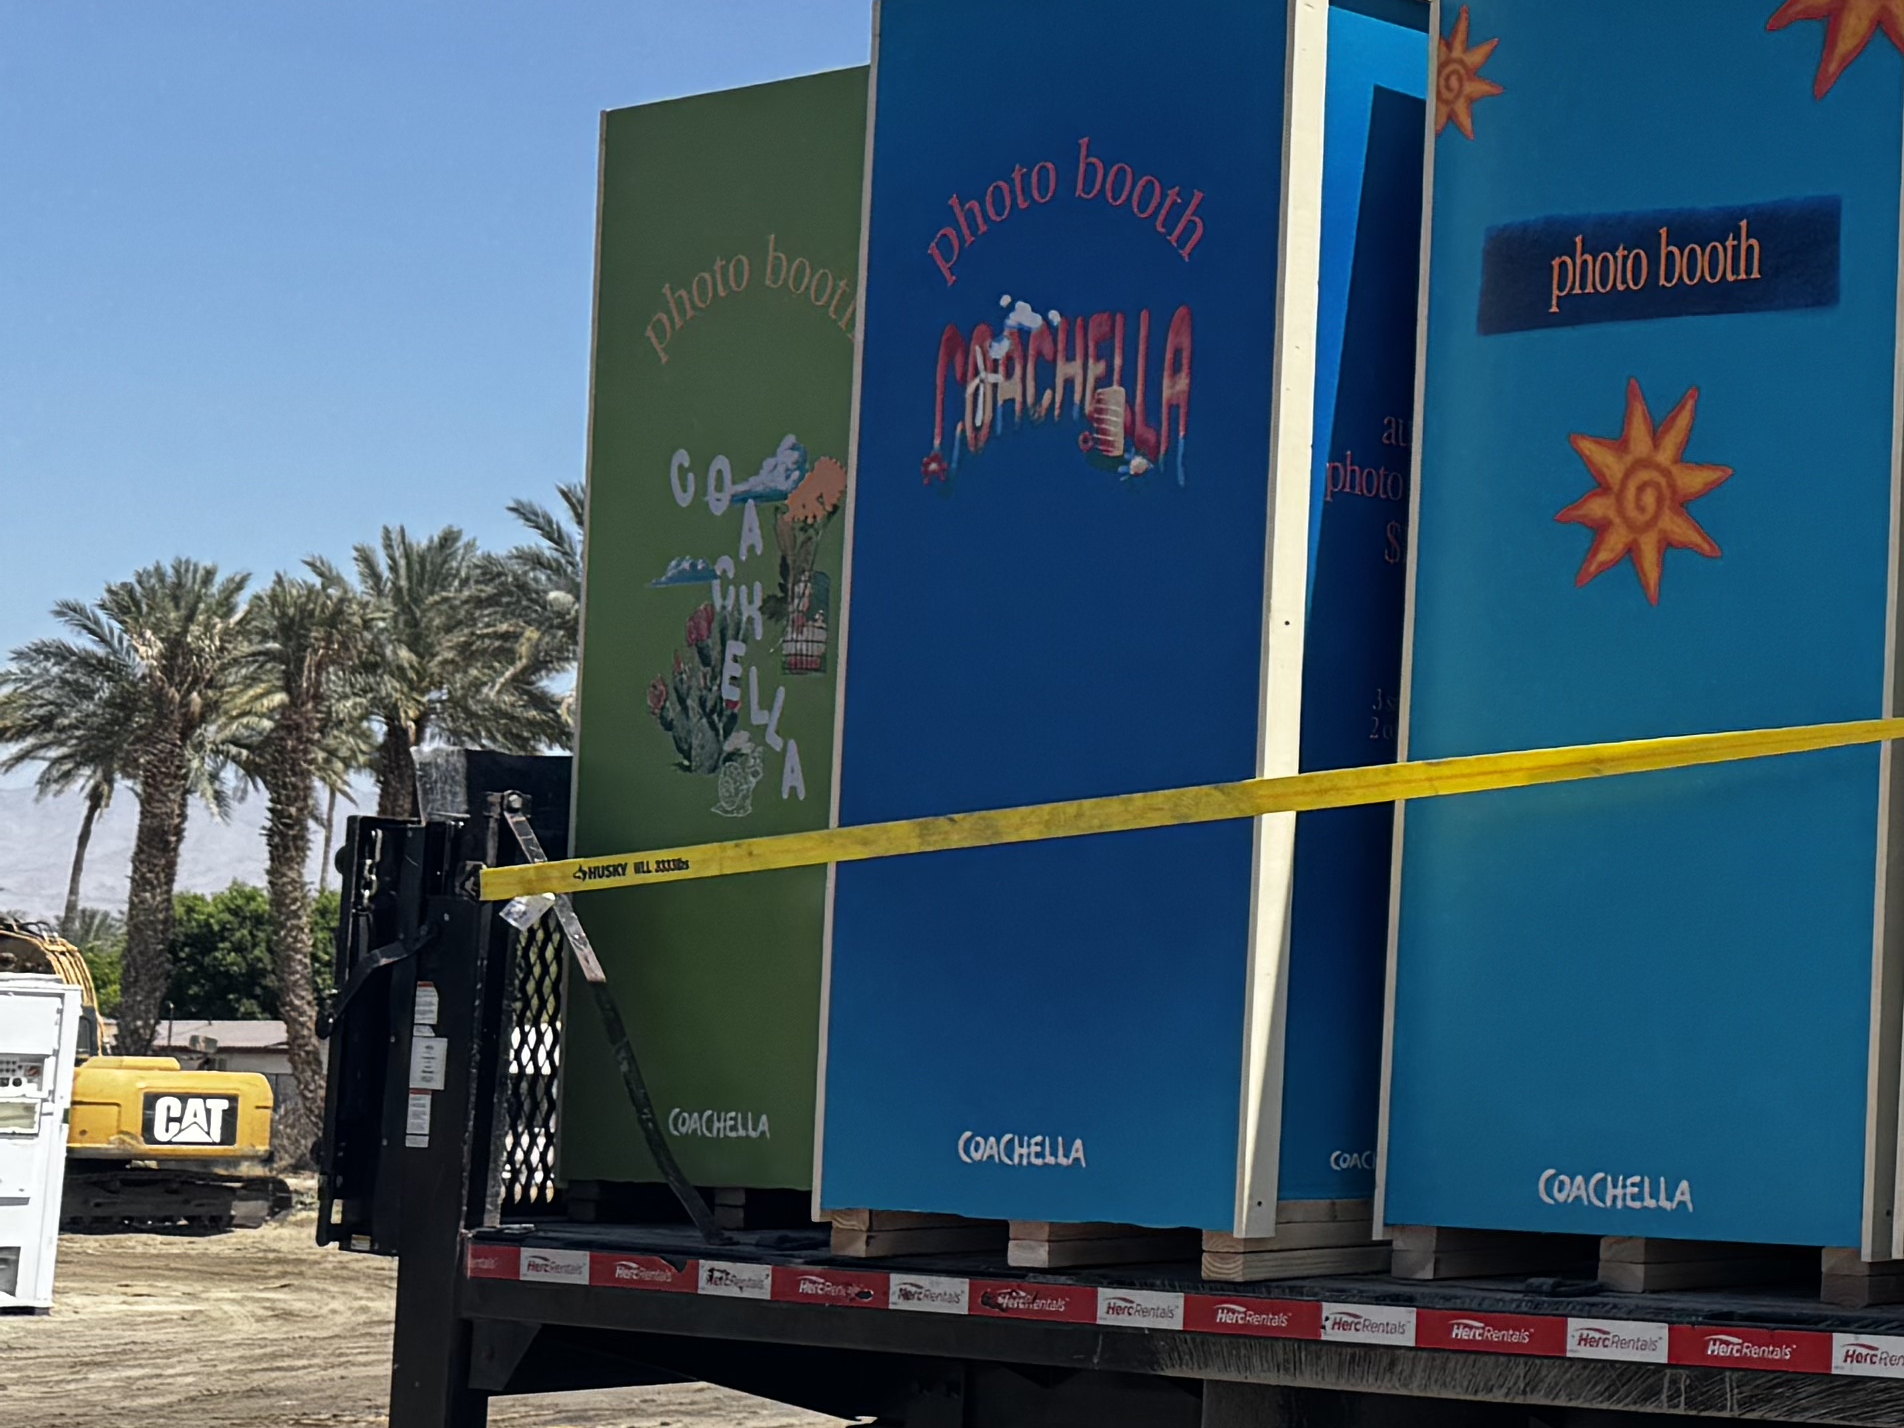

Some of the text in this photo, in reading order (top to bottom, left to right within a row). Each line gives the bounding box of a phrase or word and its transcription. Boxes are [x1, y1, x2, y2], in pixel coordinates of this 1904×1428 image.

[927, 137, 1206, 286] photo booth
[1548, 219, 1762, 313] photo booth
[645, 254, 750, 364] photo
[1325, 450, 1404, 501] photo
[588, 862, 628, 880] HUSKY
[153, 1096, 229, 1143] CAT
[667, 1107, 771, 1140] COACHELLA
[957, 1129, 1087, 1170] COACHELLA
[1538, 1169, 1693, 1212] COACHELLA
